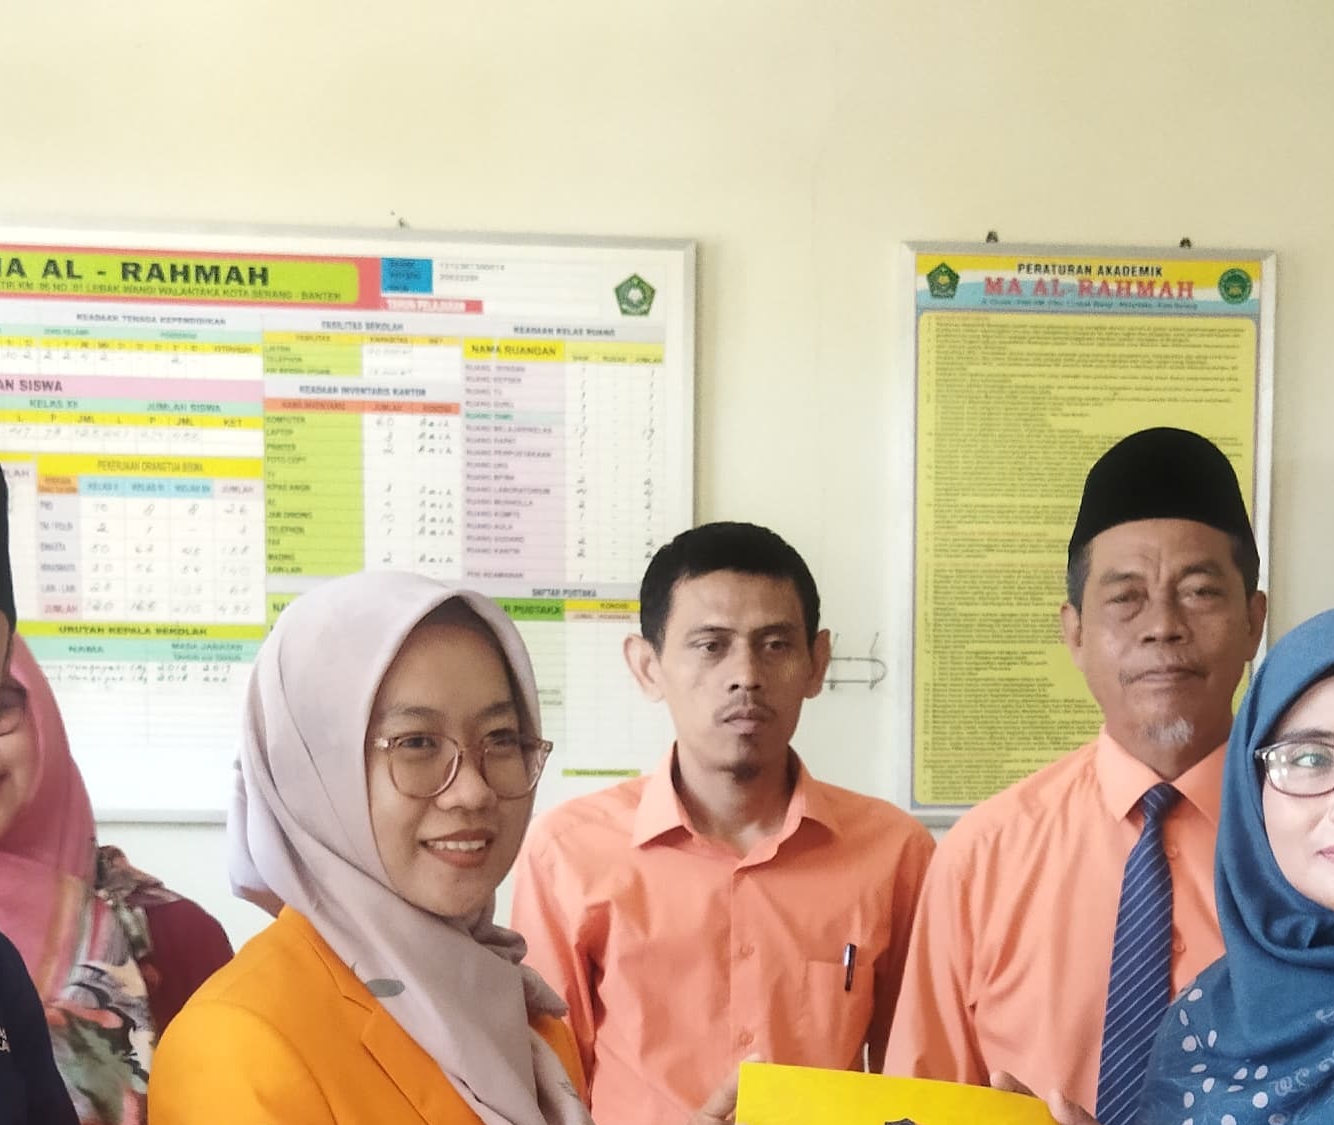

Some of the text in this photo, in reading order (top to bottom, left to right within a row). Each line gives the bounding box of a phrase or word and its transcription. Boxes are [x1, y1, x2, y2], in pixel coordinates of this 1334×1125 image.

[41, 258, 84, 281] AL
[120, 261, 270, 287] RAHMAH
[1018, 262, 1163, 278] PERATURAN AKADEMIK
[985, 277, 1196, 300] MA AL-RAHMAH
[471, 343, 557, 357] NAMA RUANGAN
[19, 378, 64, 393] SISWA
